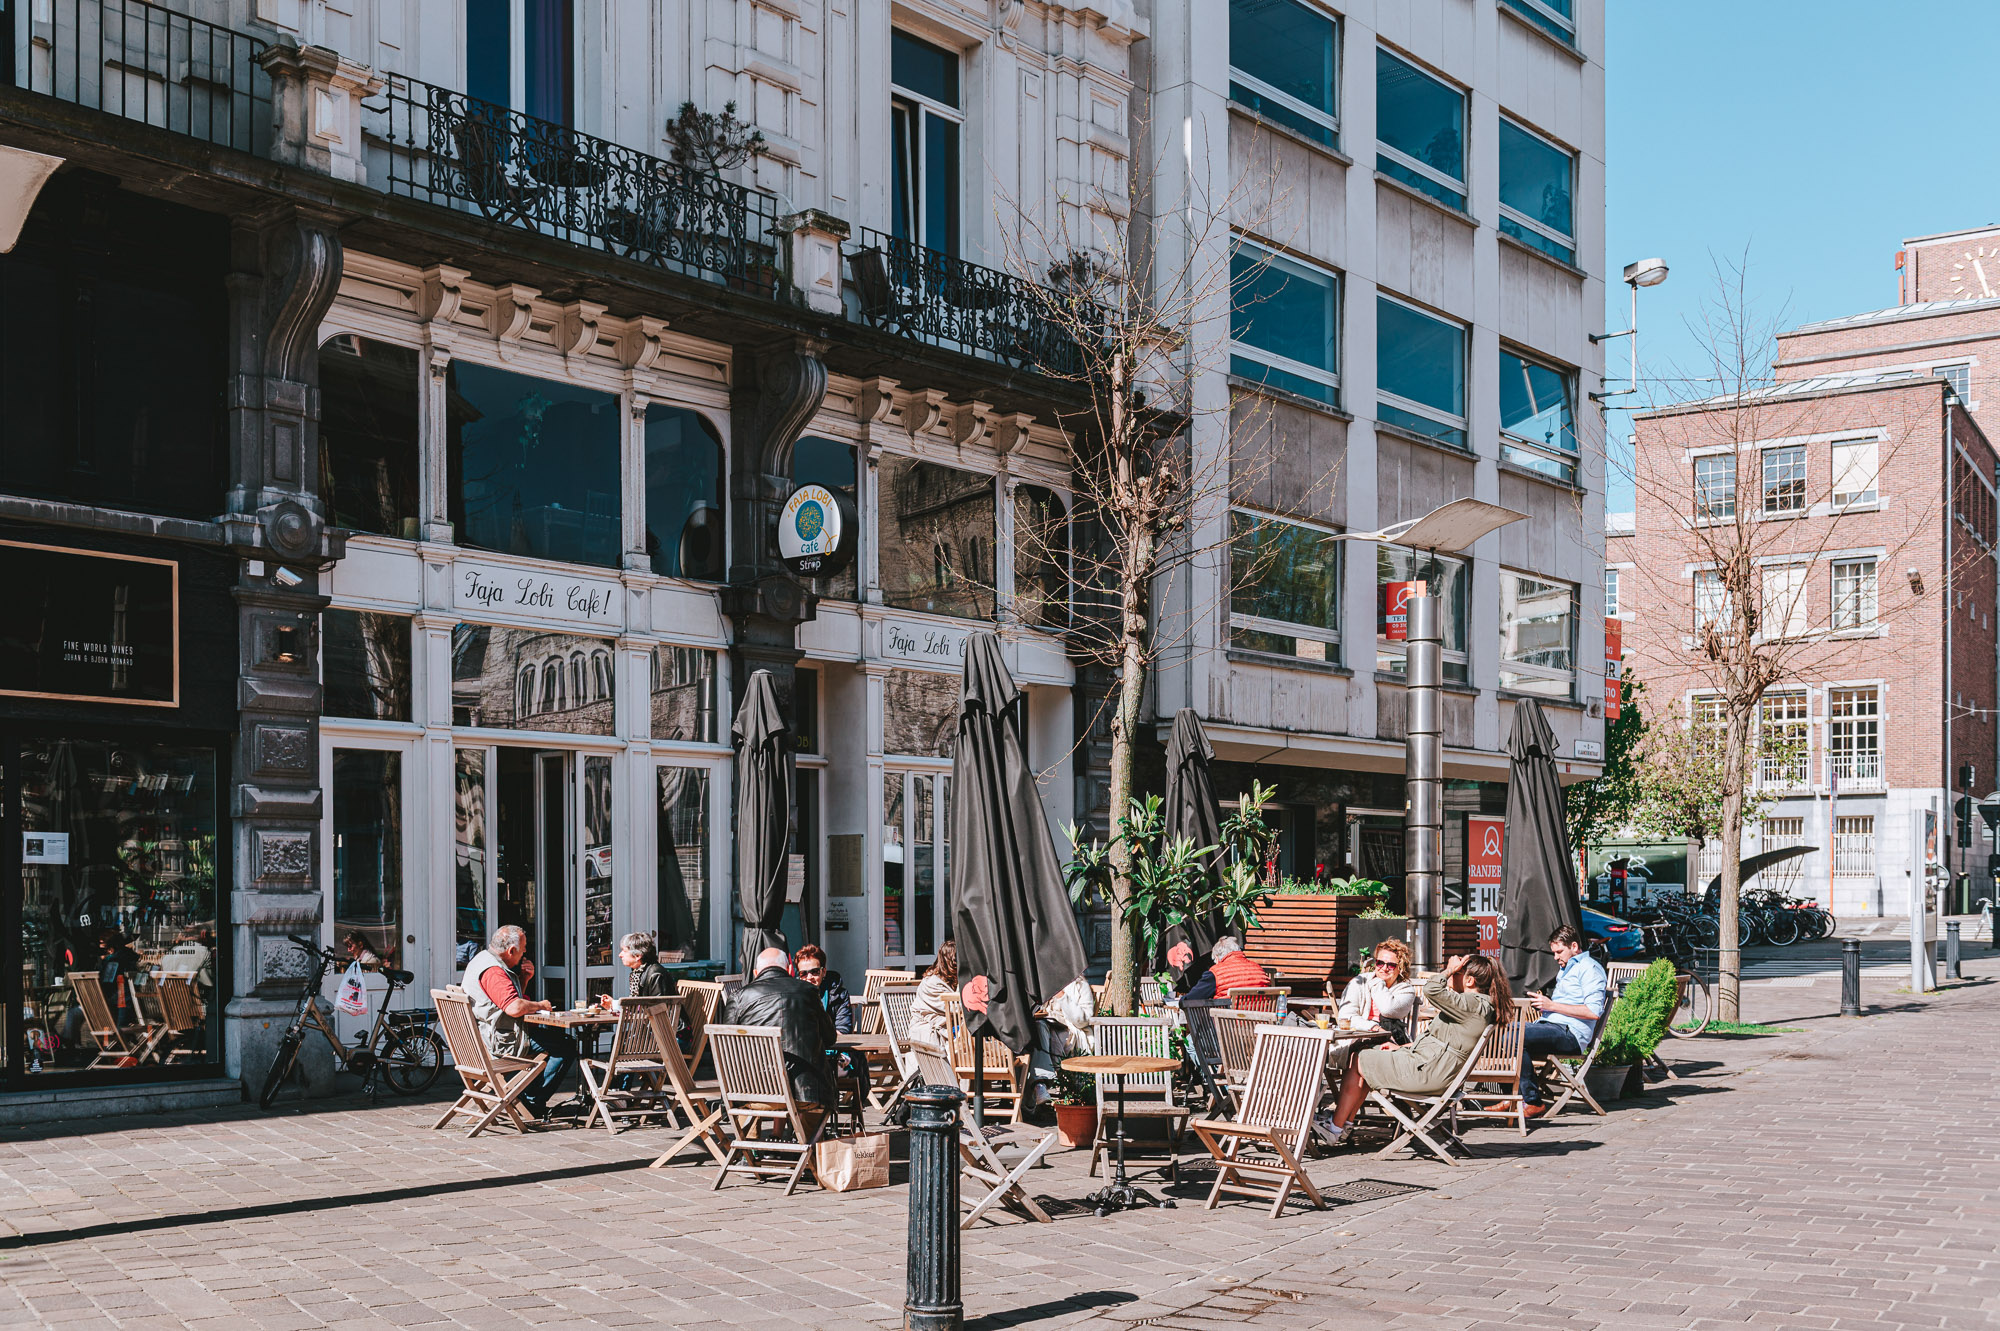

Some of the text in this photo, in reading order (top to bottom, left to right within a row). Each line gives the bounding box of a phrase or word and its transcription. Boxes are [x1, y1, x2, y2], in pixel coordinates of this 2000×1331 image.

[788, 488, 832, 513] FAJA LOBI
[801, 539, 819, 553] café
[799, 560, 821, 571] Strop
[465, 571, 504, 607] Faja
[514, 578, 554, 608] Lobi
[63, 640, 134, 656] FINE WORLD WINES
[888, 626, 916, 656] Faja
[922, 631, 950, 656] Lobi
[63, 653, 81, 661] JOHAN
